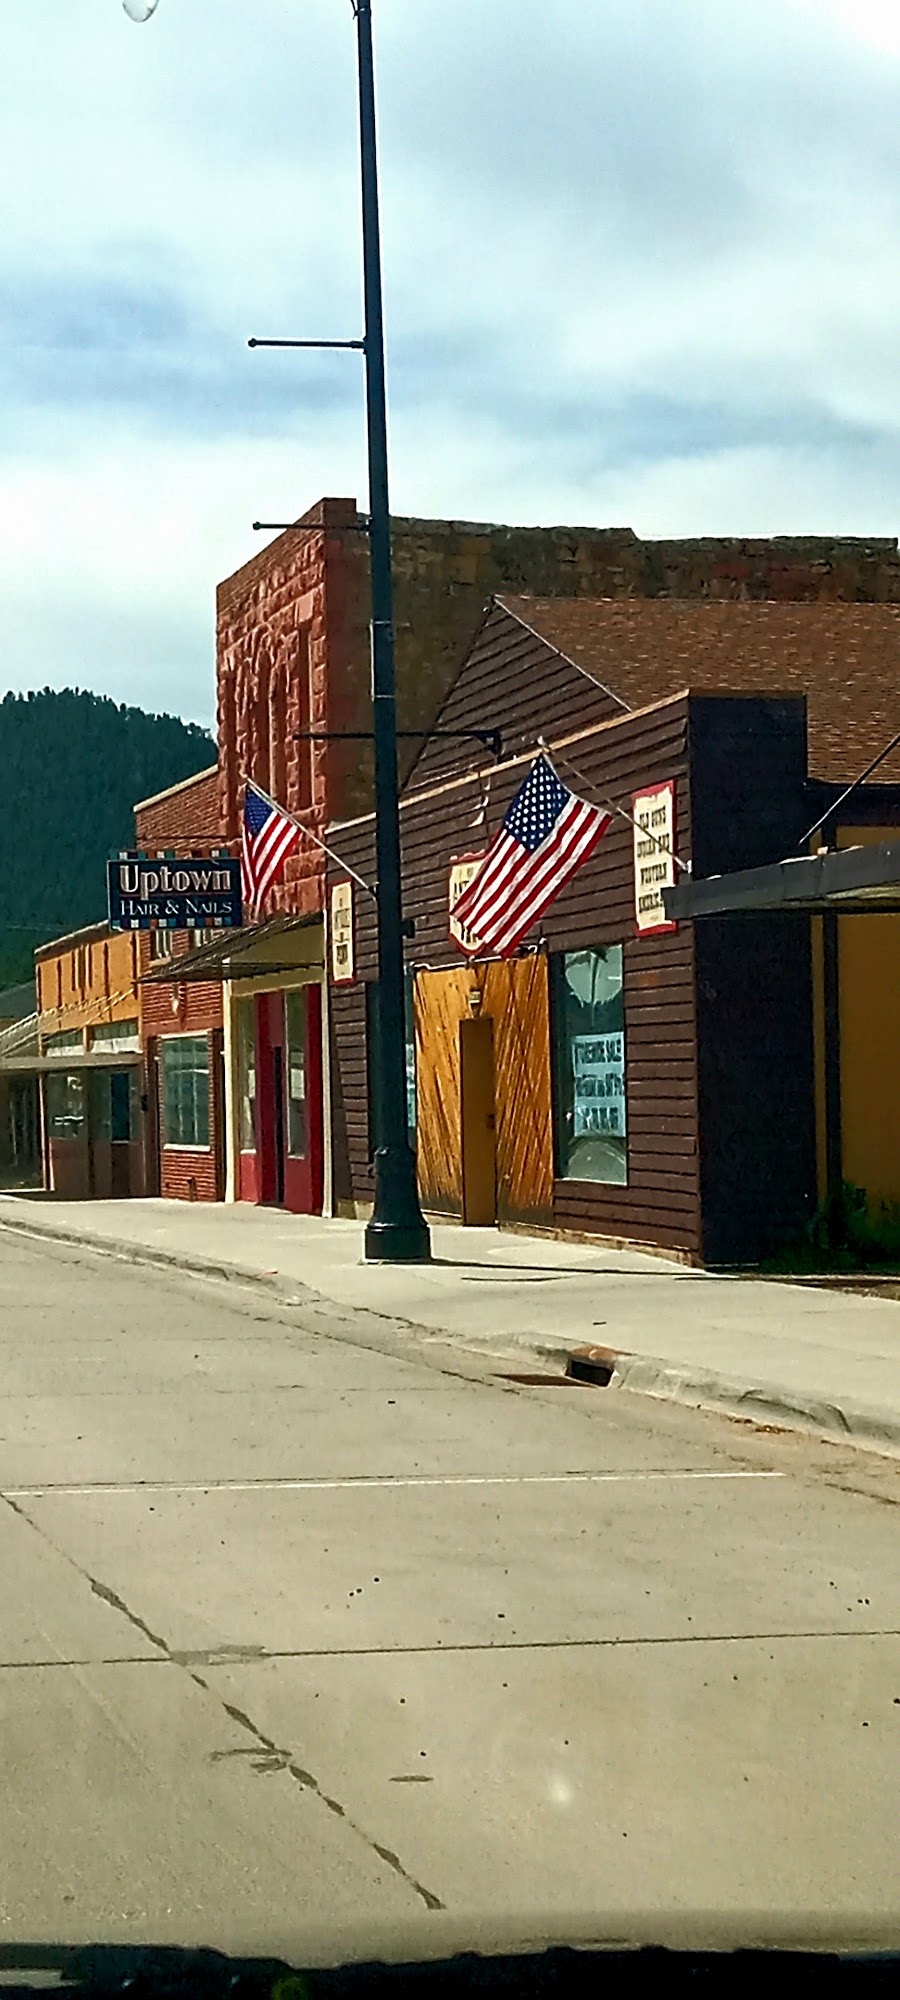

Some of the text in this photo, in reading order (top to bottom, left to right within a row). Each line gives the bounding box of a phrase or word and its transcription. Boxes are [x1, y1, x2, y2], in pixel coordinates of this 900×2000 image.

[119, 865, 231, 900] Uptown
[120, 899, 232, 915] HAIR & NAILS
